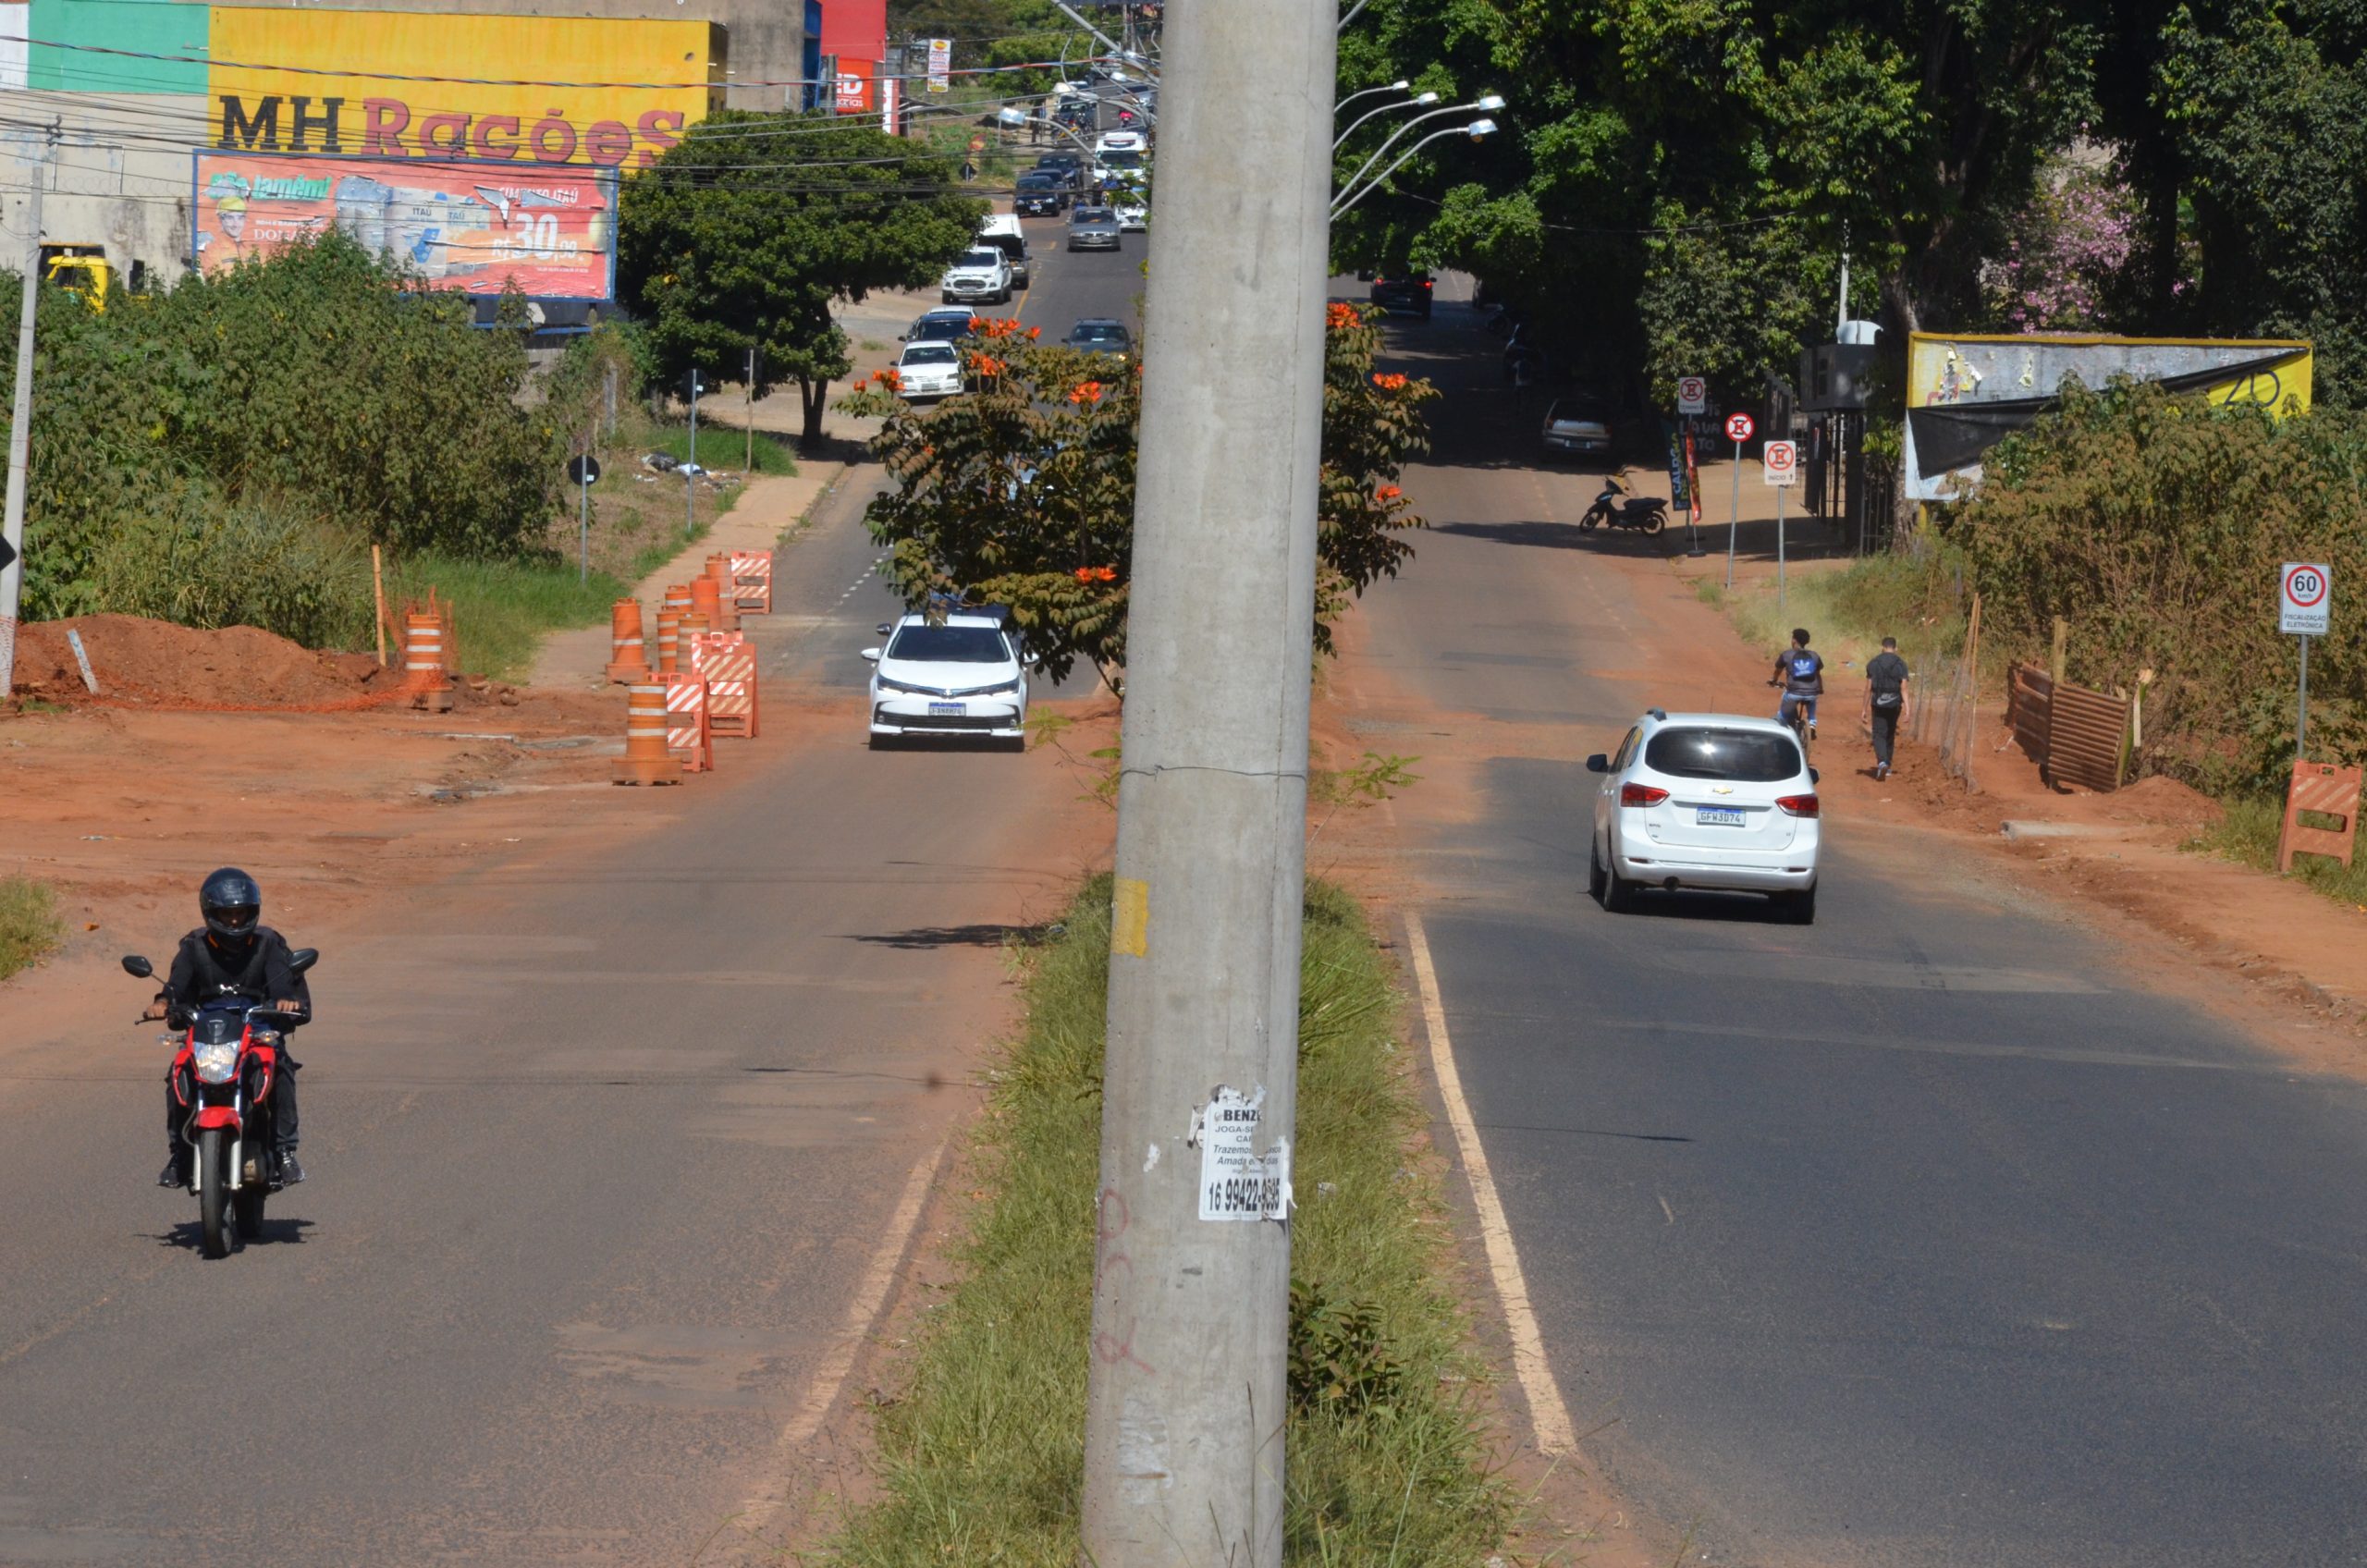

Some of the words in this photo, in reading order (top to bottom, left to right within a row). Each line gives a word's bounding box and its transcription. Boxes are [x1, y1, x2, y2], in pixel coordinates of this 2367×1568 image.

[217, 95, 344, 152] MH
[2295, 575, 2317, 592] 60
[2285, 613, 2326, 622] FISCALIZAÇÃO
[1700, 812, 1741, 823] GFW3D74
[1209, 1182, 1221, 1211] 16
